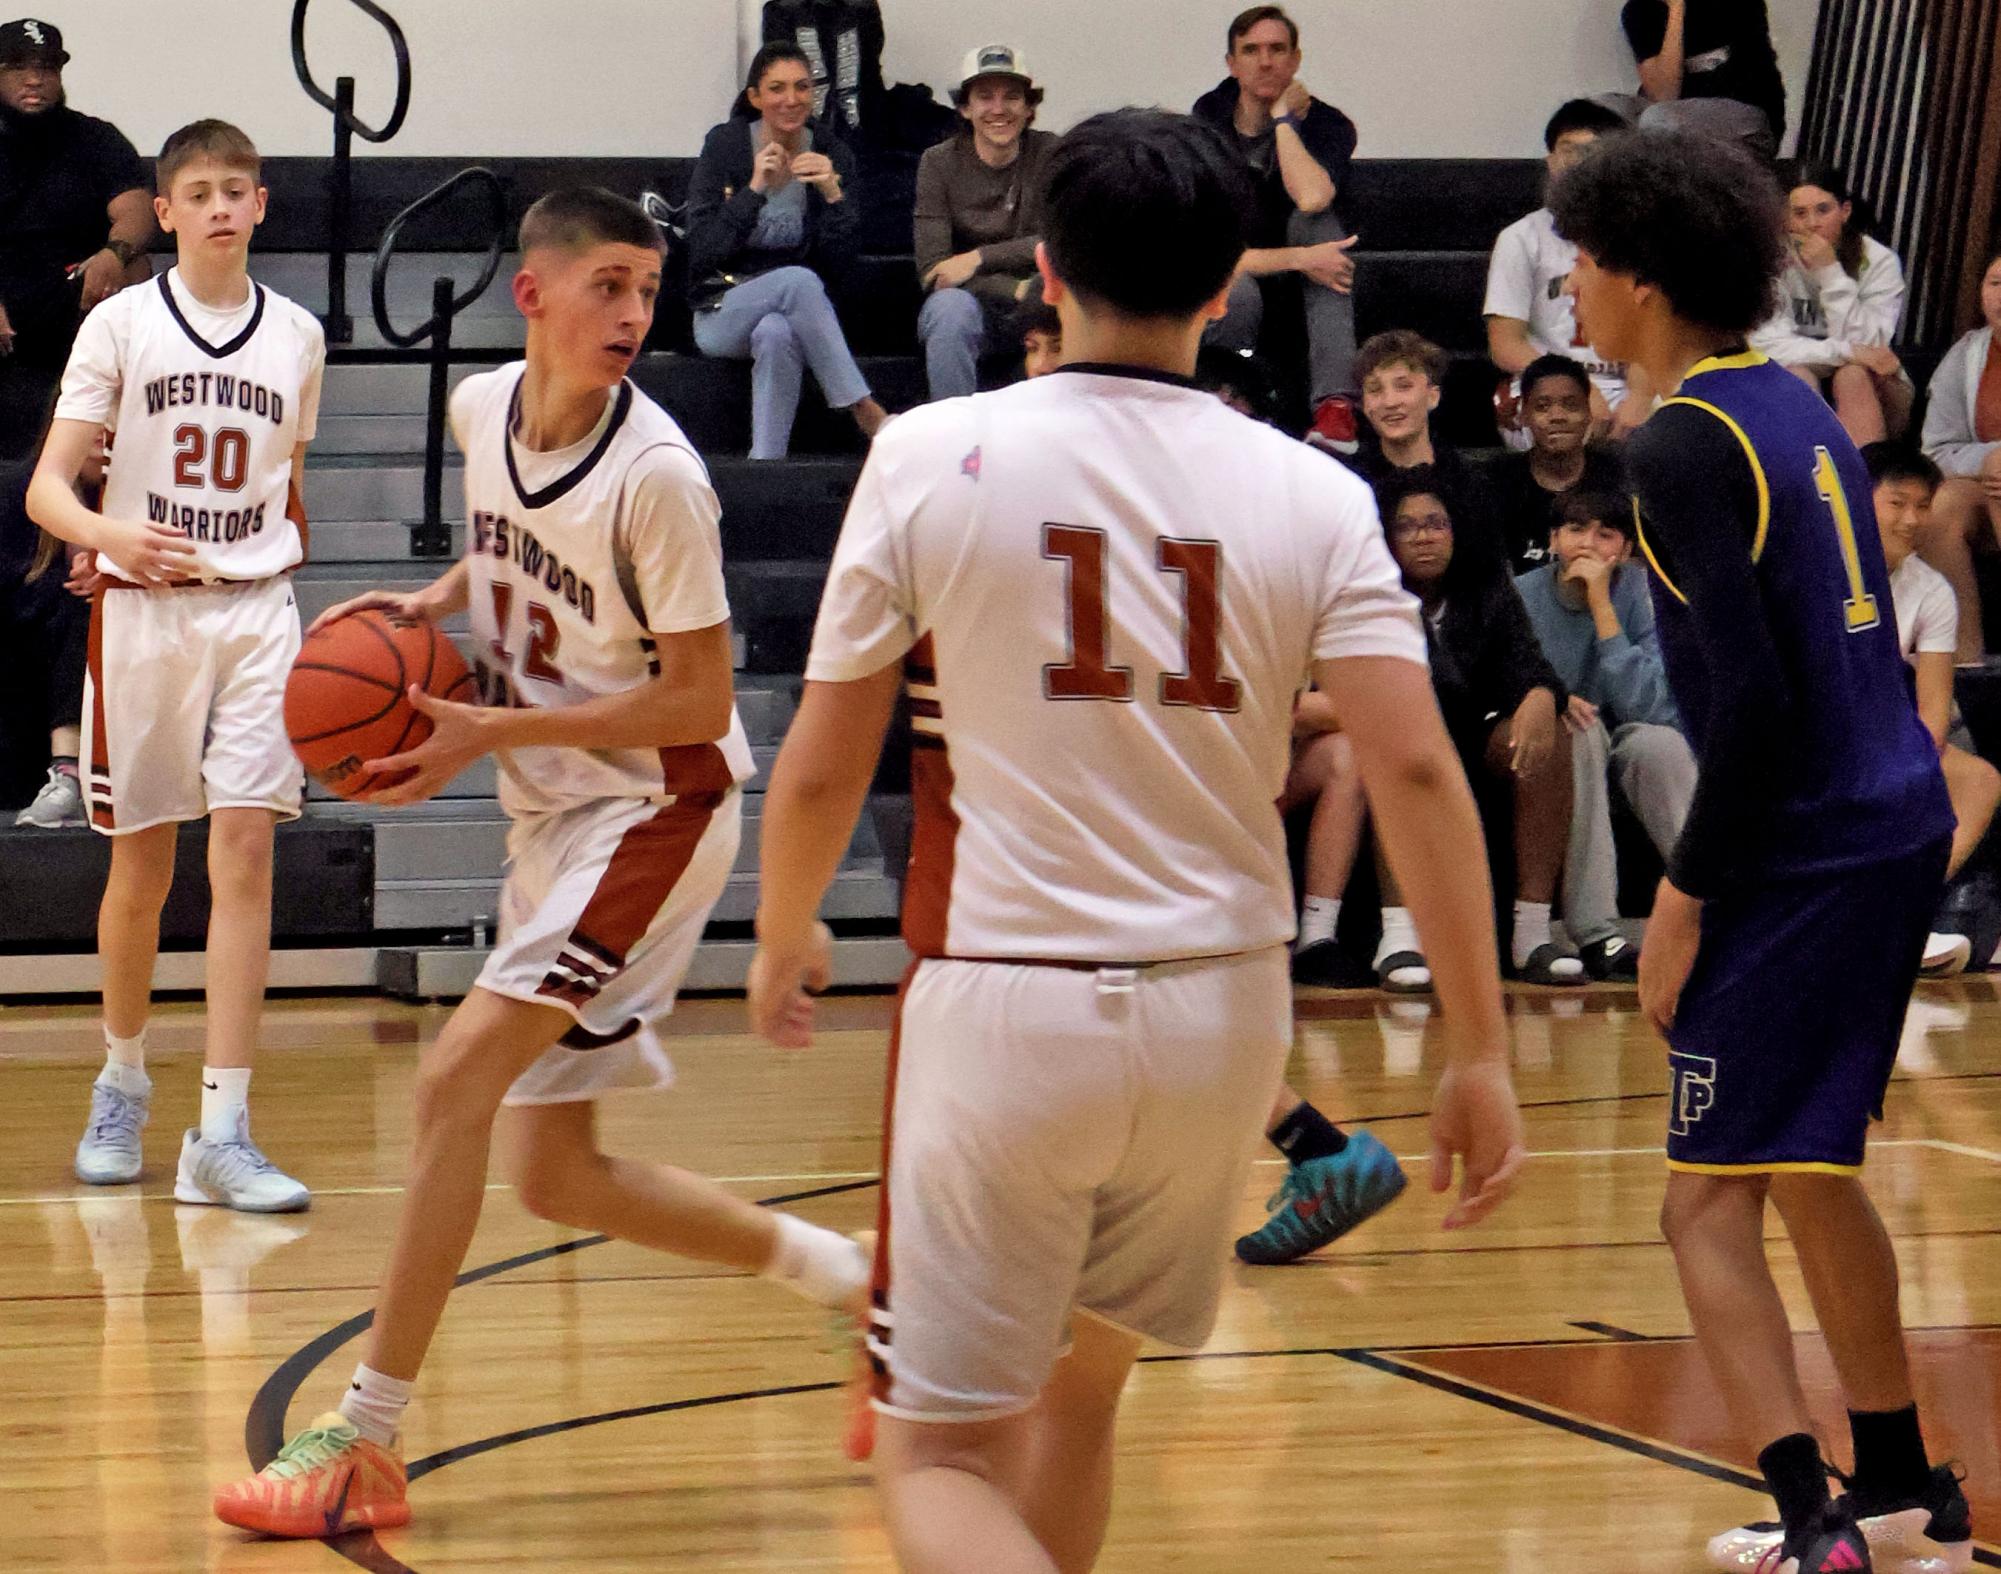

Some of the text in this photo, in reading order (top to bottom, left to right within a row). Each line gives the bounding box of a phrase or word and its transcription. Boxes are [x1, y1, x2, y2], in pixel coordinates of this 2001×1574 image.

[145, 371, 284, 425] WESTWOOD
[173, 422, 252, 494] 20
[147, 489, 266, 544] WARRIORS
[1811, 444, 1881, 634] 1
[490, 578, 566, 686] 12
[1040, 521, 1242, 713] 11
